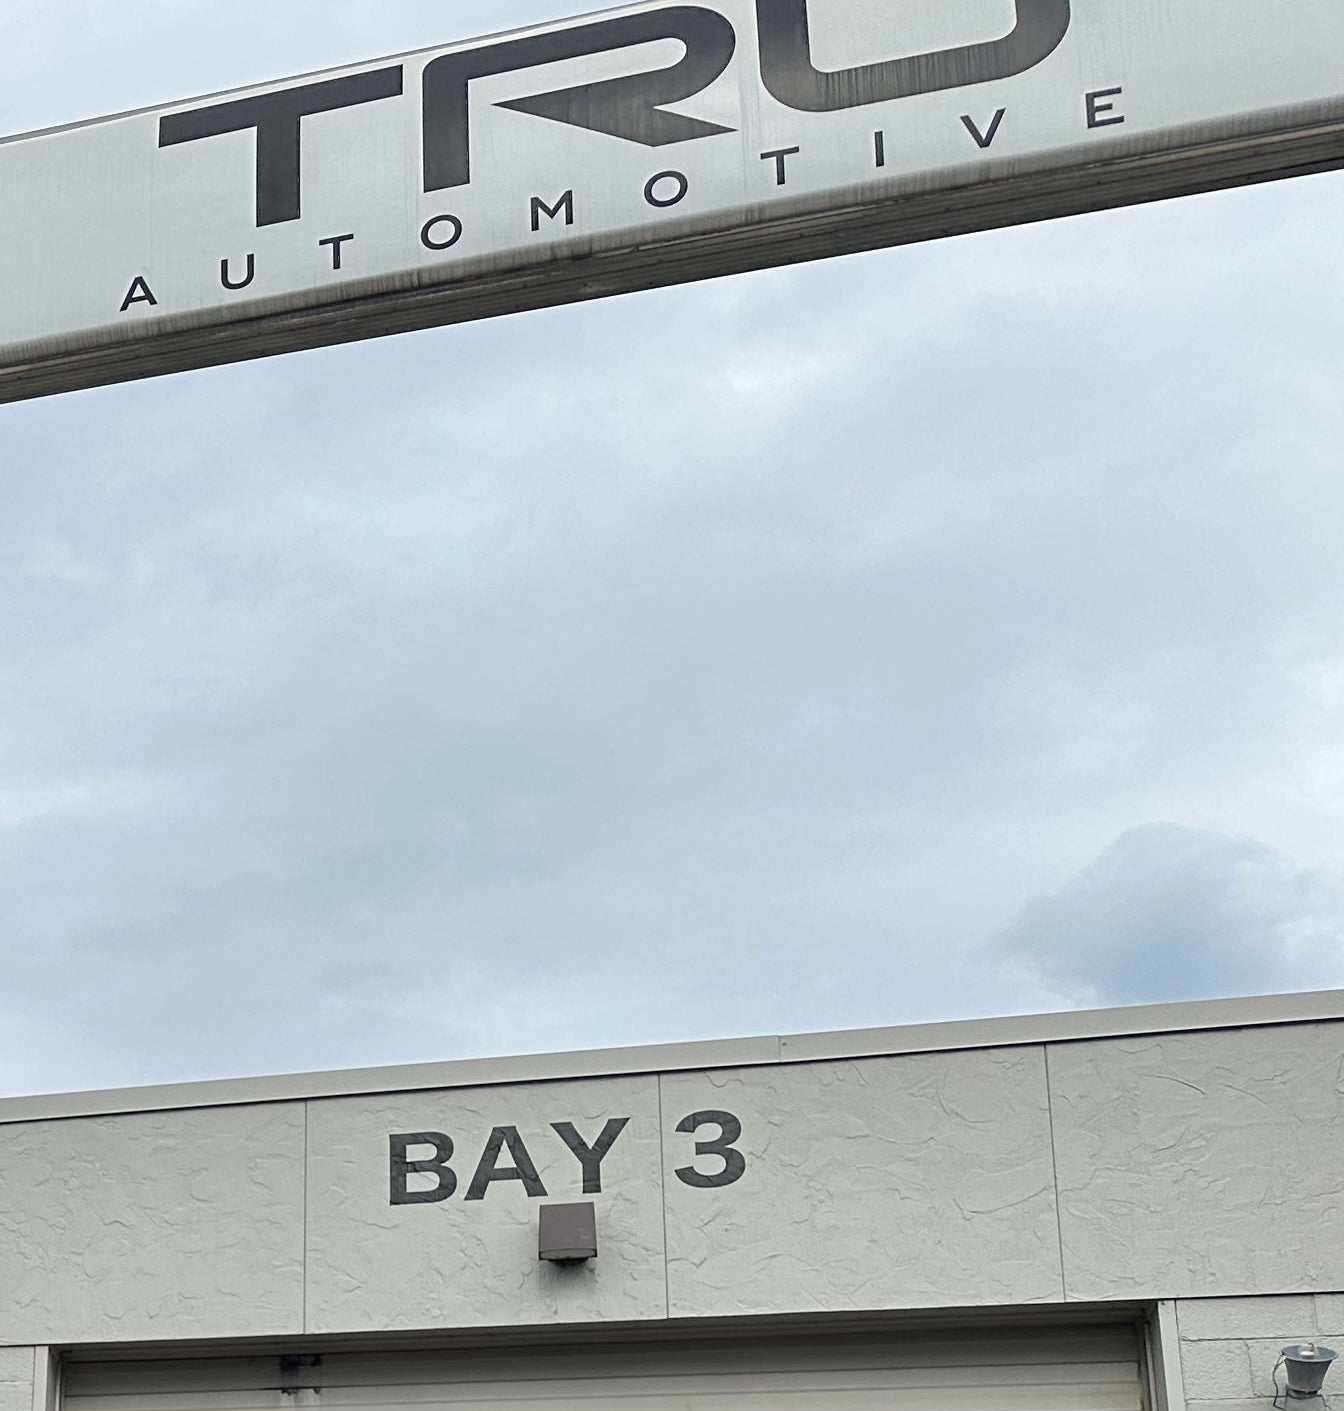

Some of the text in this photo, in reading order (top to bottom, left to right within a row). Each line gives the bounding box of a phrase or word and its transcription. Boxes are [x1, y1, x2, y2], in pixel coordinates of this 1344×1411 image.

[119, 87, 1125, 312] AUTOMOTIVE
[389, 1109, 746, 1206] BAY 3
